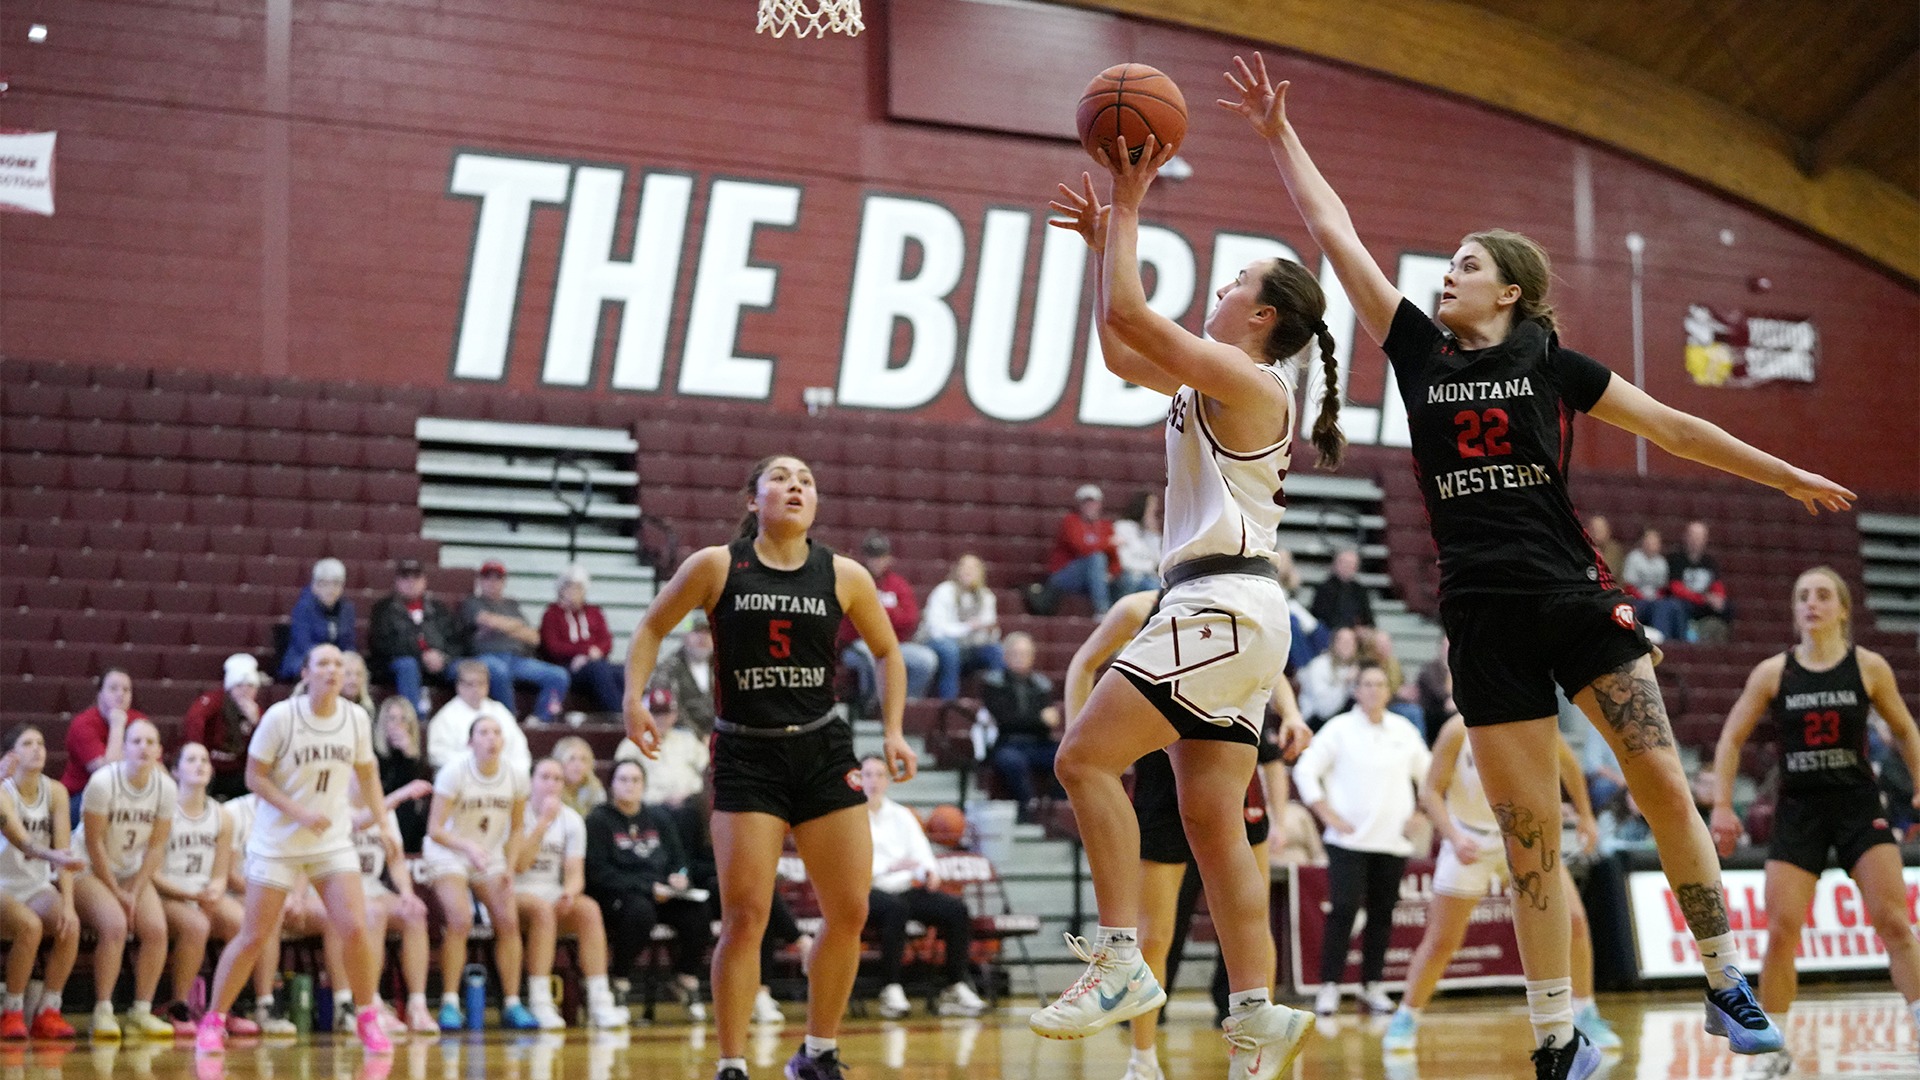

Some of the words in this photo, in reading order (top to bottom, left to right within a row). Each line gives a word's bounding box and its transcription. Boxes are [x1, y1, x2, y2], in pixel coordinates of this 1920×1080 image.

[450, 153, 803, 401] THE
[1427, 376, 1535, 404] MONTANA
[1454, 408, 1512, 459] 22
[1435, 463, 1551, 500] WESTERN
[734, 593, 827, 617] MONTANA
[769, 619, 793, 659] 5
[734, 666, 825, 691] WESTERN
[1785, 690, 1858, 710] MONTANA
[1804, 710, 1840, 746] 23
[1785, 748, 1857, 772] WESTERN
[316, 769, 331, 793] 11
[123, 829, 137, 851] 3
